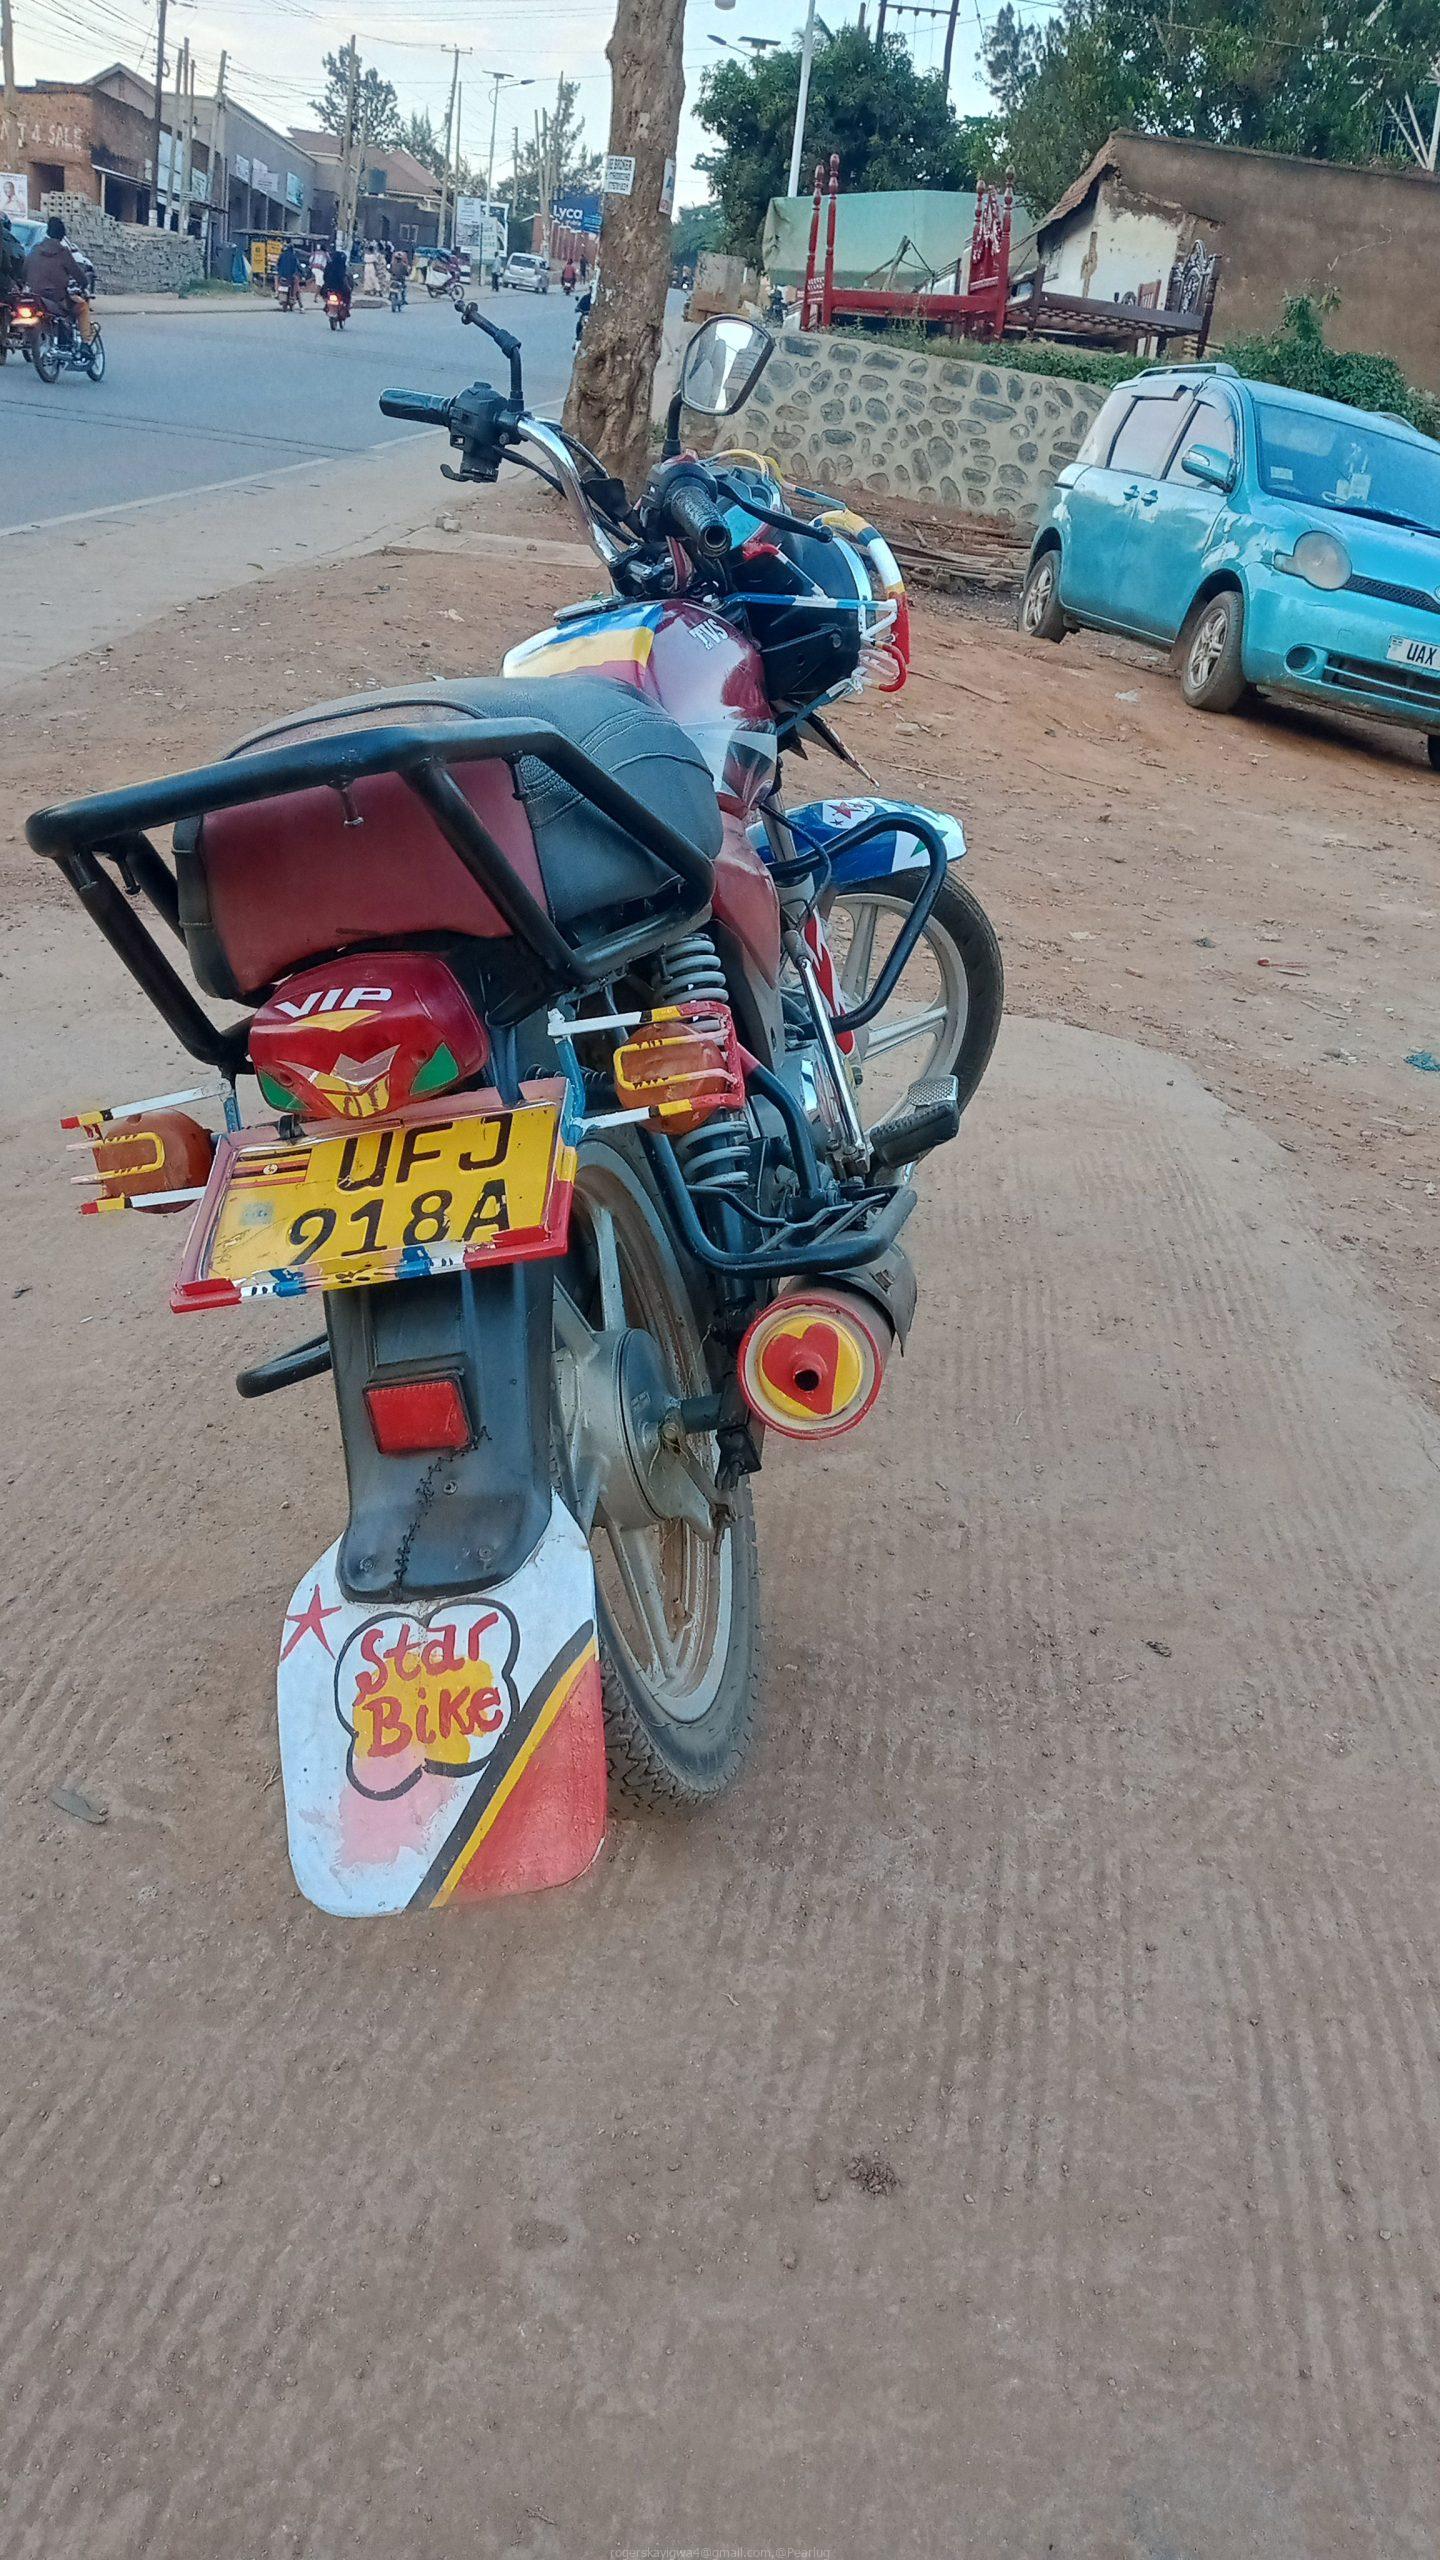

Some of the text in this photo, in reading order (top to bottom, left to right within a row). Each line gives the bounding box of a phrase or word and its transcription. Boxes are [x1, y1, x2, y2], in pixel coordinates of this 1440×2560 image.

[48, 125, 82, 152] SALE
[553, 205, 583, 220] Lyca
[689, 618, 729, 650] TVS
[1407, 642, 1437, 666] UAX
[273, 986, 393, 1018] VIP
[336, 1111, 514, 1192] UFJ
[288, 1177, 511, 1266] 918A
[353, 1611, 500, 1706] Star
